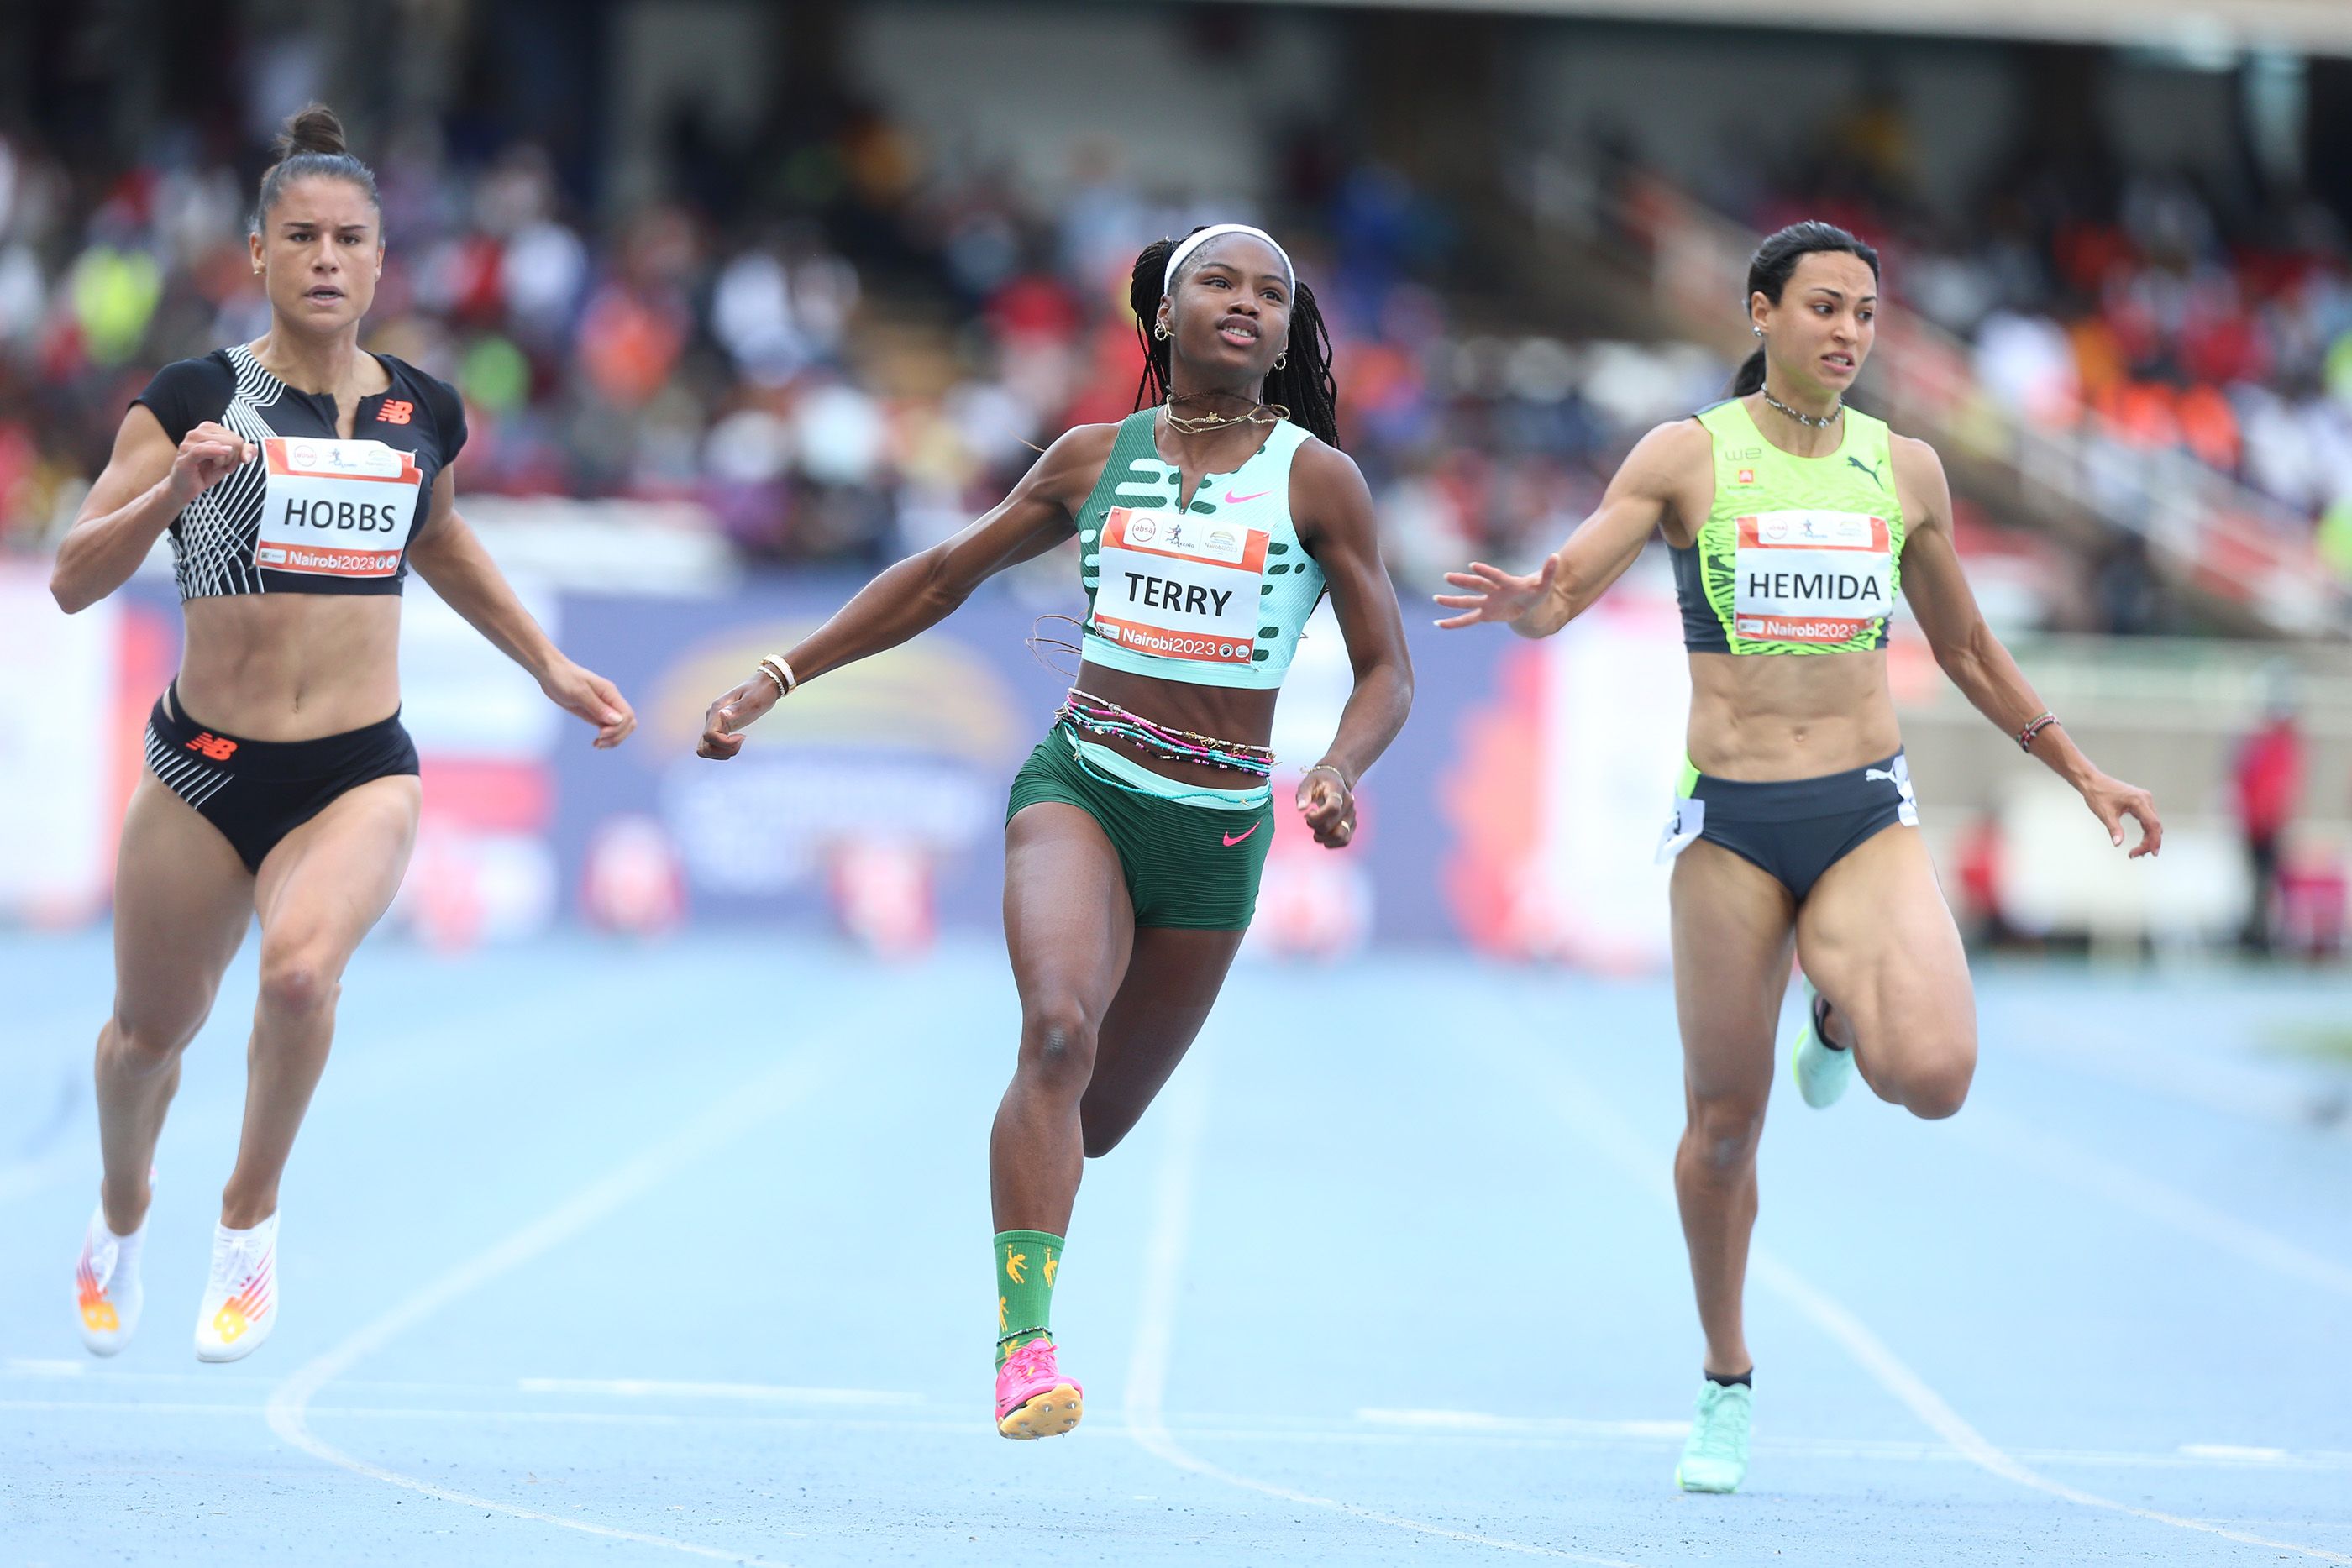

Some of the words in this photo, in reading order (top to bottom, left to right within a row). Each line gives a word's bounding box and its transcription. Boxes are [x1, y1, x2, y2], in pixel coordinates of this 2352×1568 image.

[284, 497, 396, 533] HOBBS
[1135, 524, 1153, 534] absa
[288, 550, 375, 570] Nairobi2023
[1124, 571, 1233, 617] TERRY
[1749, 573, 1881, 601] HEMIDA
[1122, 627, 1215, 656] Nairobi2023
[1767, 621, 1858, 639] Nairobi2023
